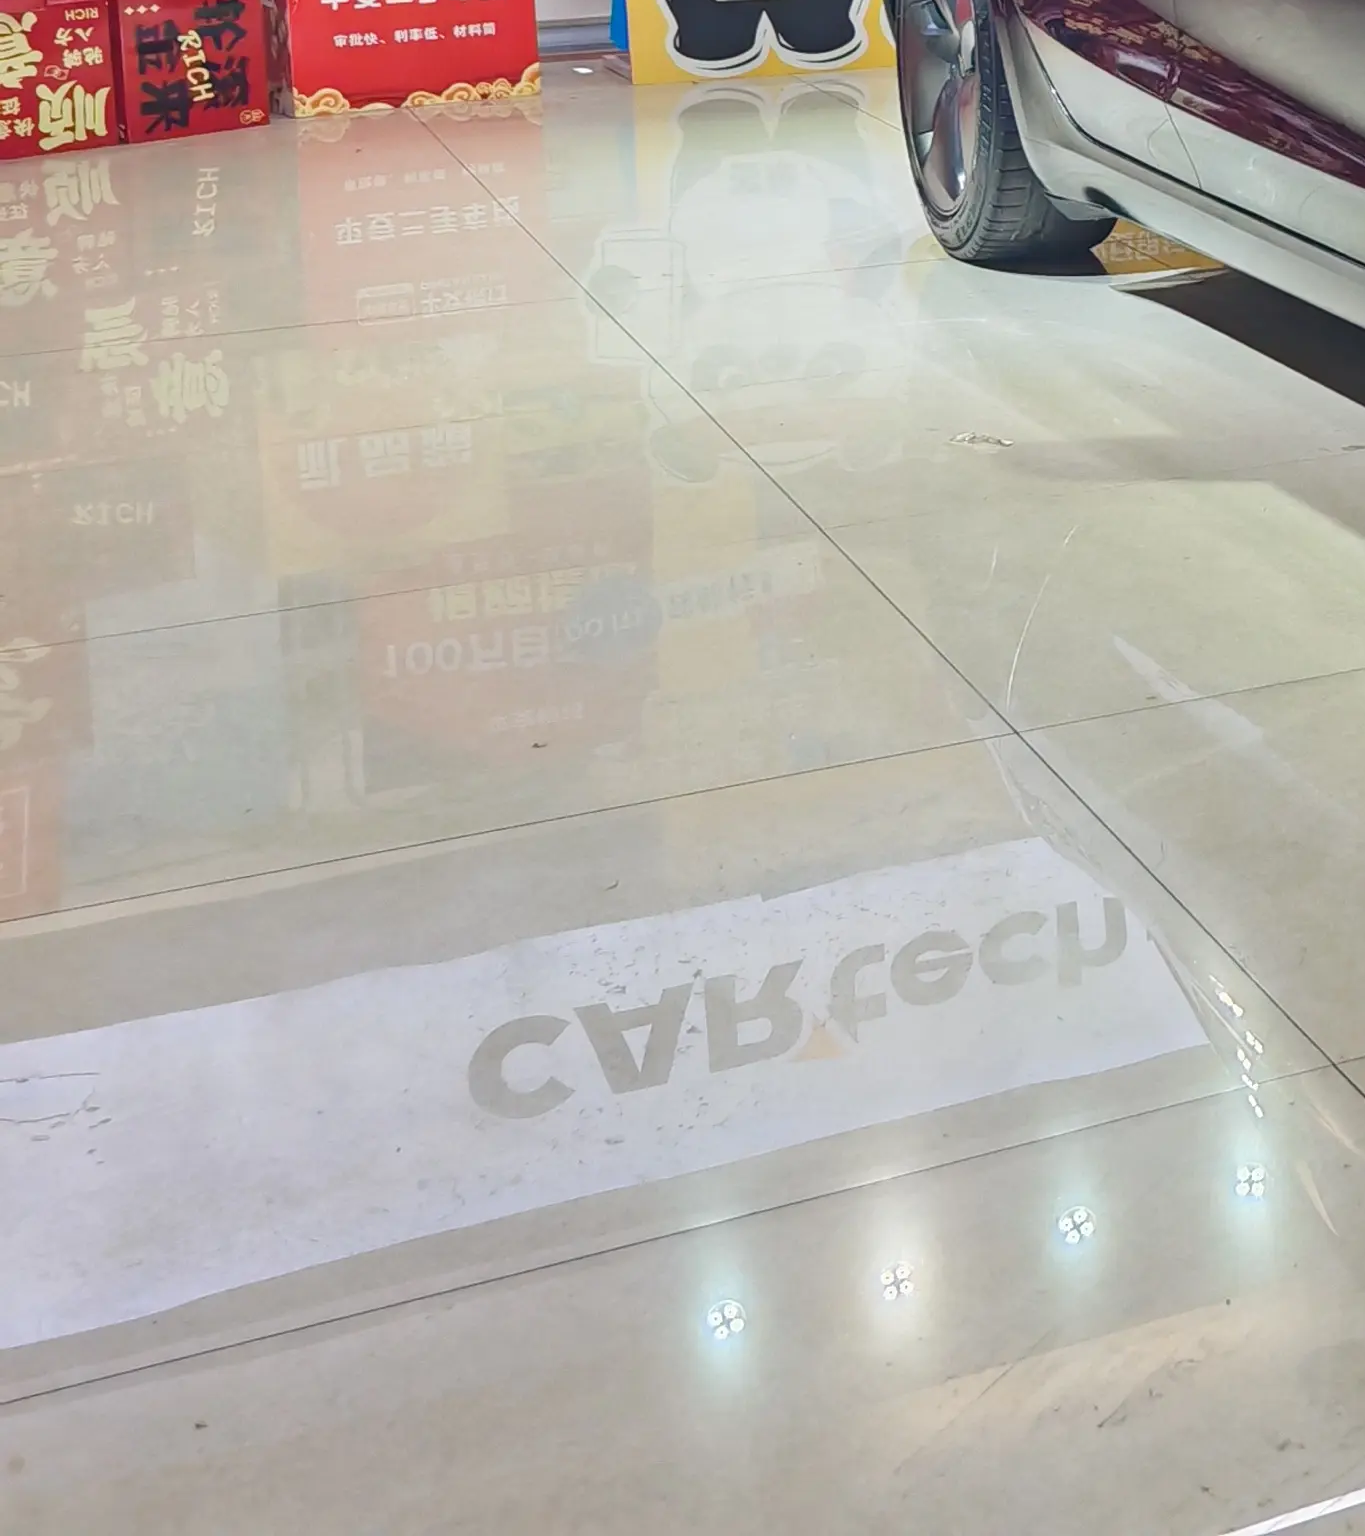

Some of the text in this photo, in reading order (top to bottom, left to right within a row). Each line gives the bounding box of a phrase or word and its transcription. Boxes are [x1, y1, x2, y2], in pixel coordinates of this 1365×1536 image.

[64, 6, 100, 21] RICH
[176, 28, 216, 103] RICH
[34, 79, 112, 152] 顺
